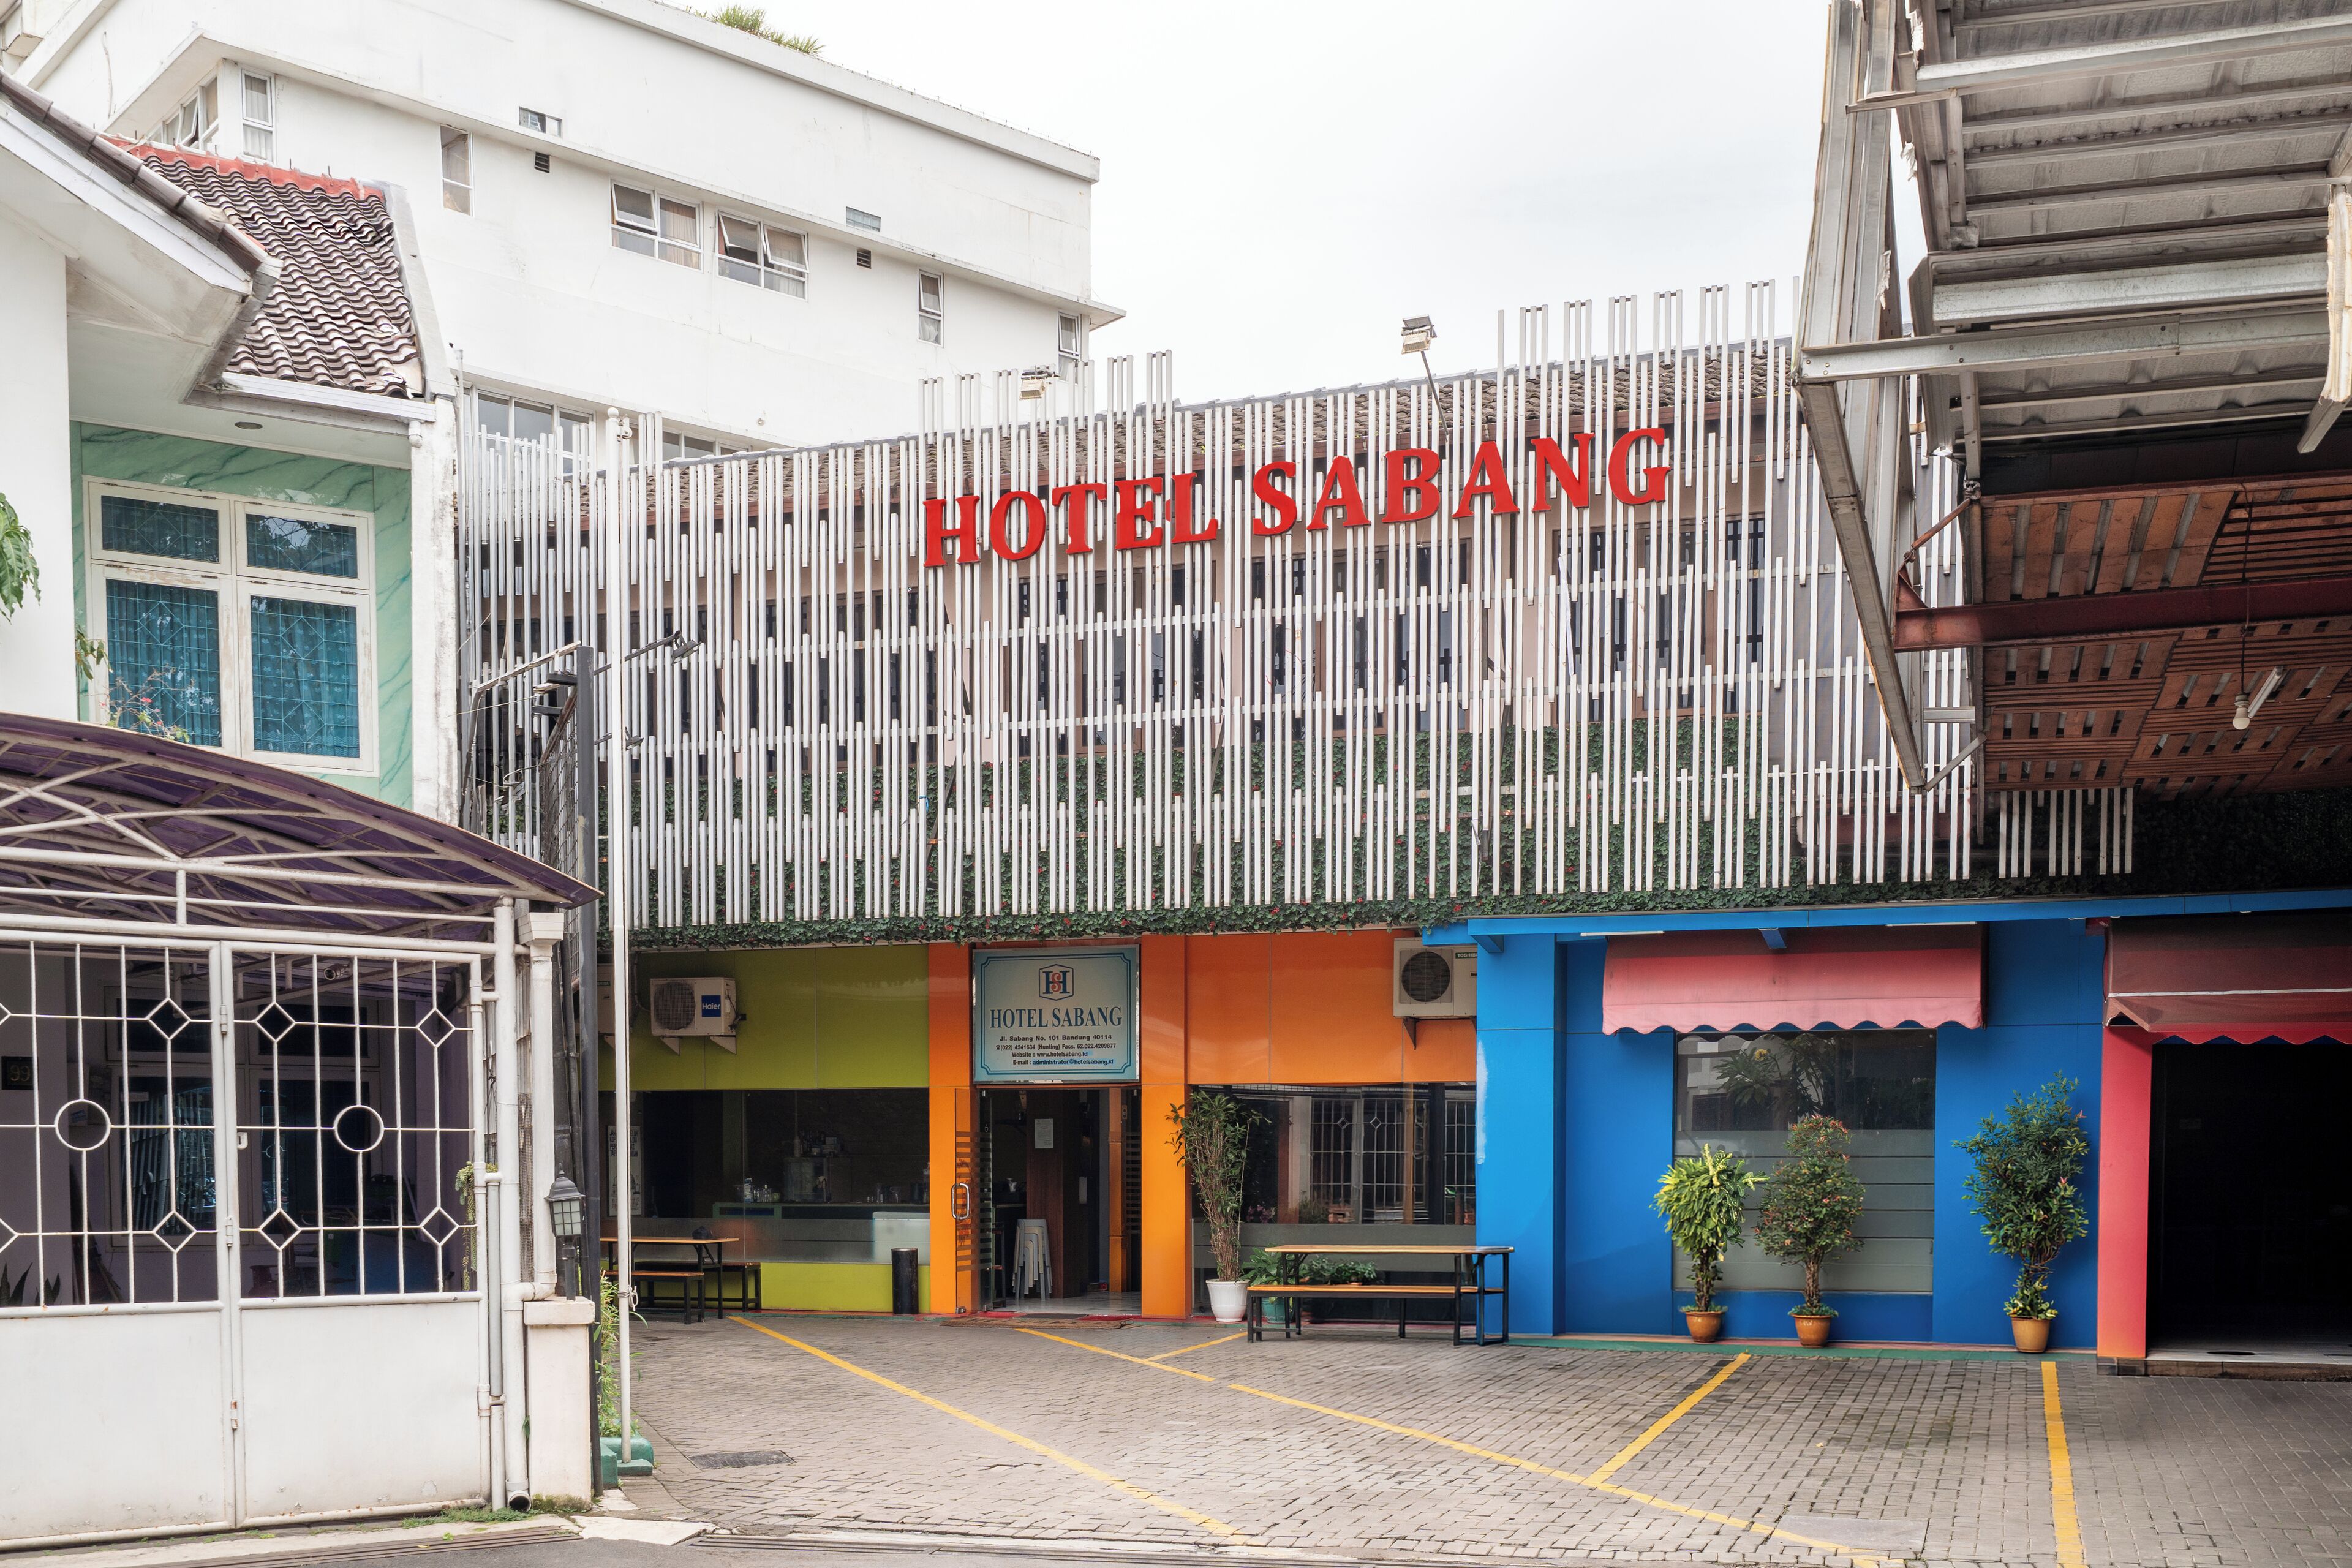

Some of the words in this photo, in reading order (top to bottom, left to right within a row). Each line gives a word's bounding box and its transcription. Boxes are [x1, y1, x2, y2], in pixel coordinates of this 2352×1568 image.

[922, 472, 1219, 568] HOTEL
[1252, 427, 1672, 537] SABANG
[990, 1008, 1049, 1028] HOTEL
[1052, 1006, 1123, 1028] SABANG
[10, 1065, 31, 1082] 99
